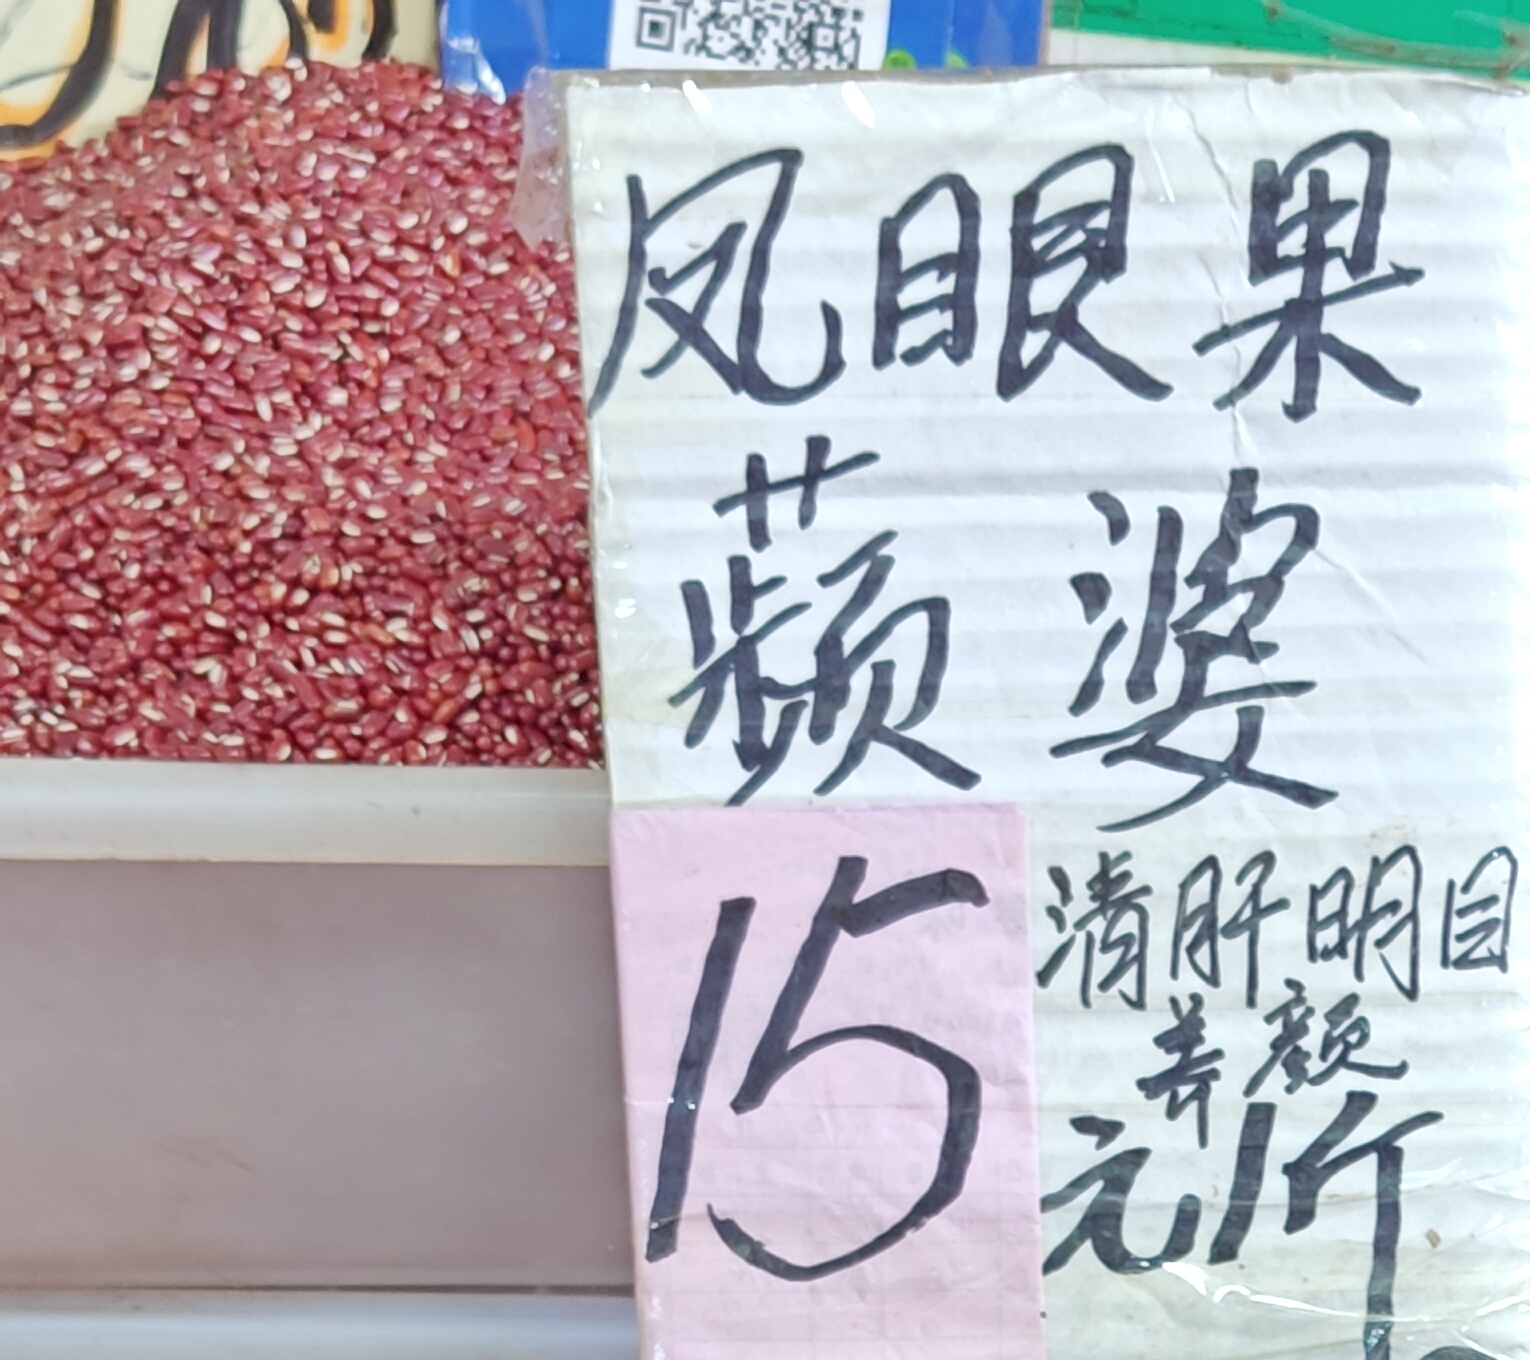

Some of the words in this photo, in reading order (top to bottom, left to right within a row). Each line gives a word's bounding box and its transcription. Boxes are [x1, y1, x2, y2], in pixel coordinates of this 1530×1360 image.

[588, 128, 1425, 422] 凤眼果
[645, 854, 990, 1283] 15
[1035, 845, 1519, 1011] 清肝明目
